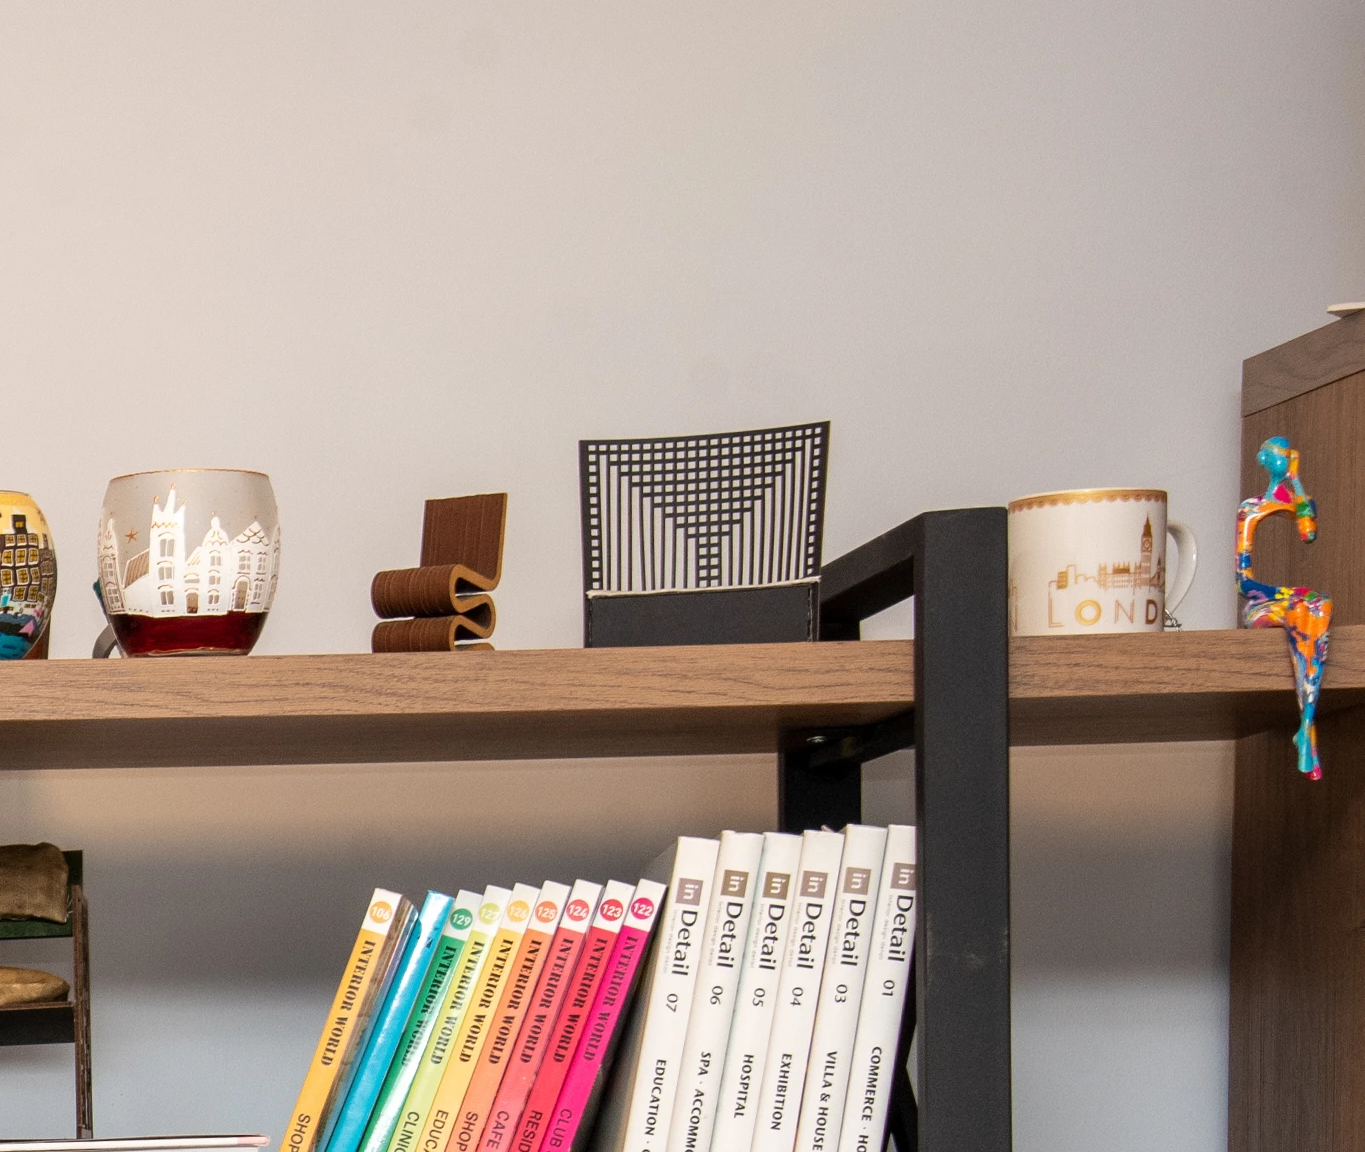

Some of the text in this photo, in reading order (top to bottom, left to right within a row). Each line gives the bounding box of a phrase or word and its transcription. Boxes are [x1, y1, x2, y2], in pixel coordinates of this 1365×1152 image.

[1048, 597, 1165, 628] LOND
[372, 906, 390, 920] 106
[452, 913, 471, 926] 129
[509, 905, 527, 918] 126
[538, 906, 557, 919] 125
[569, 905, 588, 918] 124
[602, 905, 621, 918] 123
[633, 902, 652, 916] 122
[881, 894, 914, 996] Detail 01
[421, 945, 459, 1019] INTERIOR
[665, 909, 698, 1012] Detail 07
[709, 901, 744, 1005] Detail 06
[751, 903, 785, 1006] Detail 05
[789, 902, 823, 1006] Detail 04
[834, 898, 867, 1003] Detail 03
[320, 939, 376, 1065] INTERIOR WORLD
[430, 940, 485, 1064] INTERIOR WORLD
[458, 938, 513, 1062] INTERIOR WORLD
[488, 939, 542, 1064] INTERIOR WORLD
[519, 937, 574, 1063] INTERIOR WORLD
[553, 937, 608, 1063] INTERIOR WORLD
[583, 935, 638, 1061] INTERIOR WORLD
[644, 1058, 667, 1136] EDUCATION
[697, 1051, 711, 1075] SPA
[733, 1053, 754, 1117] HOSPITAL
[770, 1052, 792, 1130] EXHIBITION
[821, 1050, 837, 1088] VILLA
[861, 1045, 882, 1121] COMMERCE
[455, 1110, 478, 1152] SHOP
[485, 1109, 510, 1149] CAFE
[548, 1108, 573, 1148] CLUB
[812, 1106, 829, 1150] HOUSE
